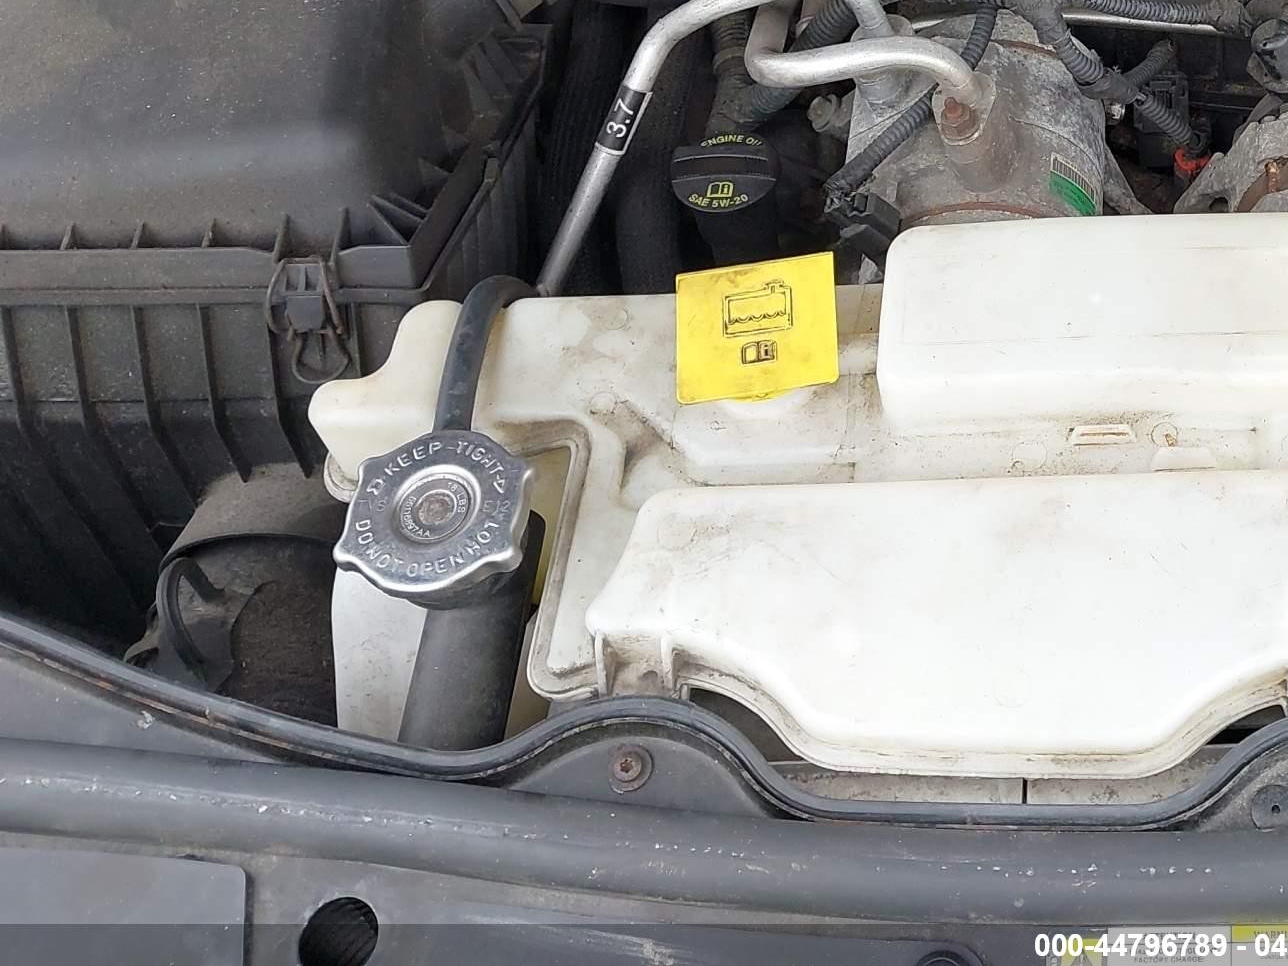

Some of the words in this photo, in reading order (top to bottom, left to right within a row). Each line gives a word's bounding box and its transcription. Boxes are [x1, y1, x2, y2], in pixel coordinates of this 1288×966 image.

[606, 98, 634, 138] 3.7
[700, 134, 744, 147] ENGINE
[688, 193, 710, 207] SAE
[711, 193, 749, 208] 5W-20
[384, 441, 442, 477] KEEP
[456, 440, 505, 475] TIGHT
[355, 519, 375, 546] DO
[366, 543, 404, 572] NOT
[406, 551, 465, 577] OPEN
[466, 520, 500, 556] HOT
[1133, 955, 1169, 964] FACTORY
